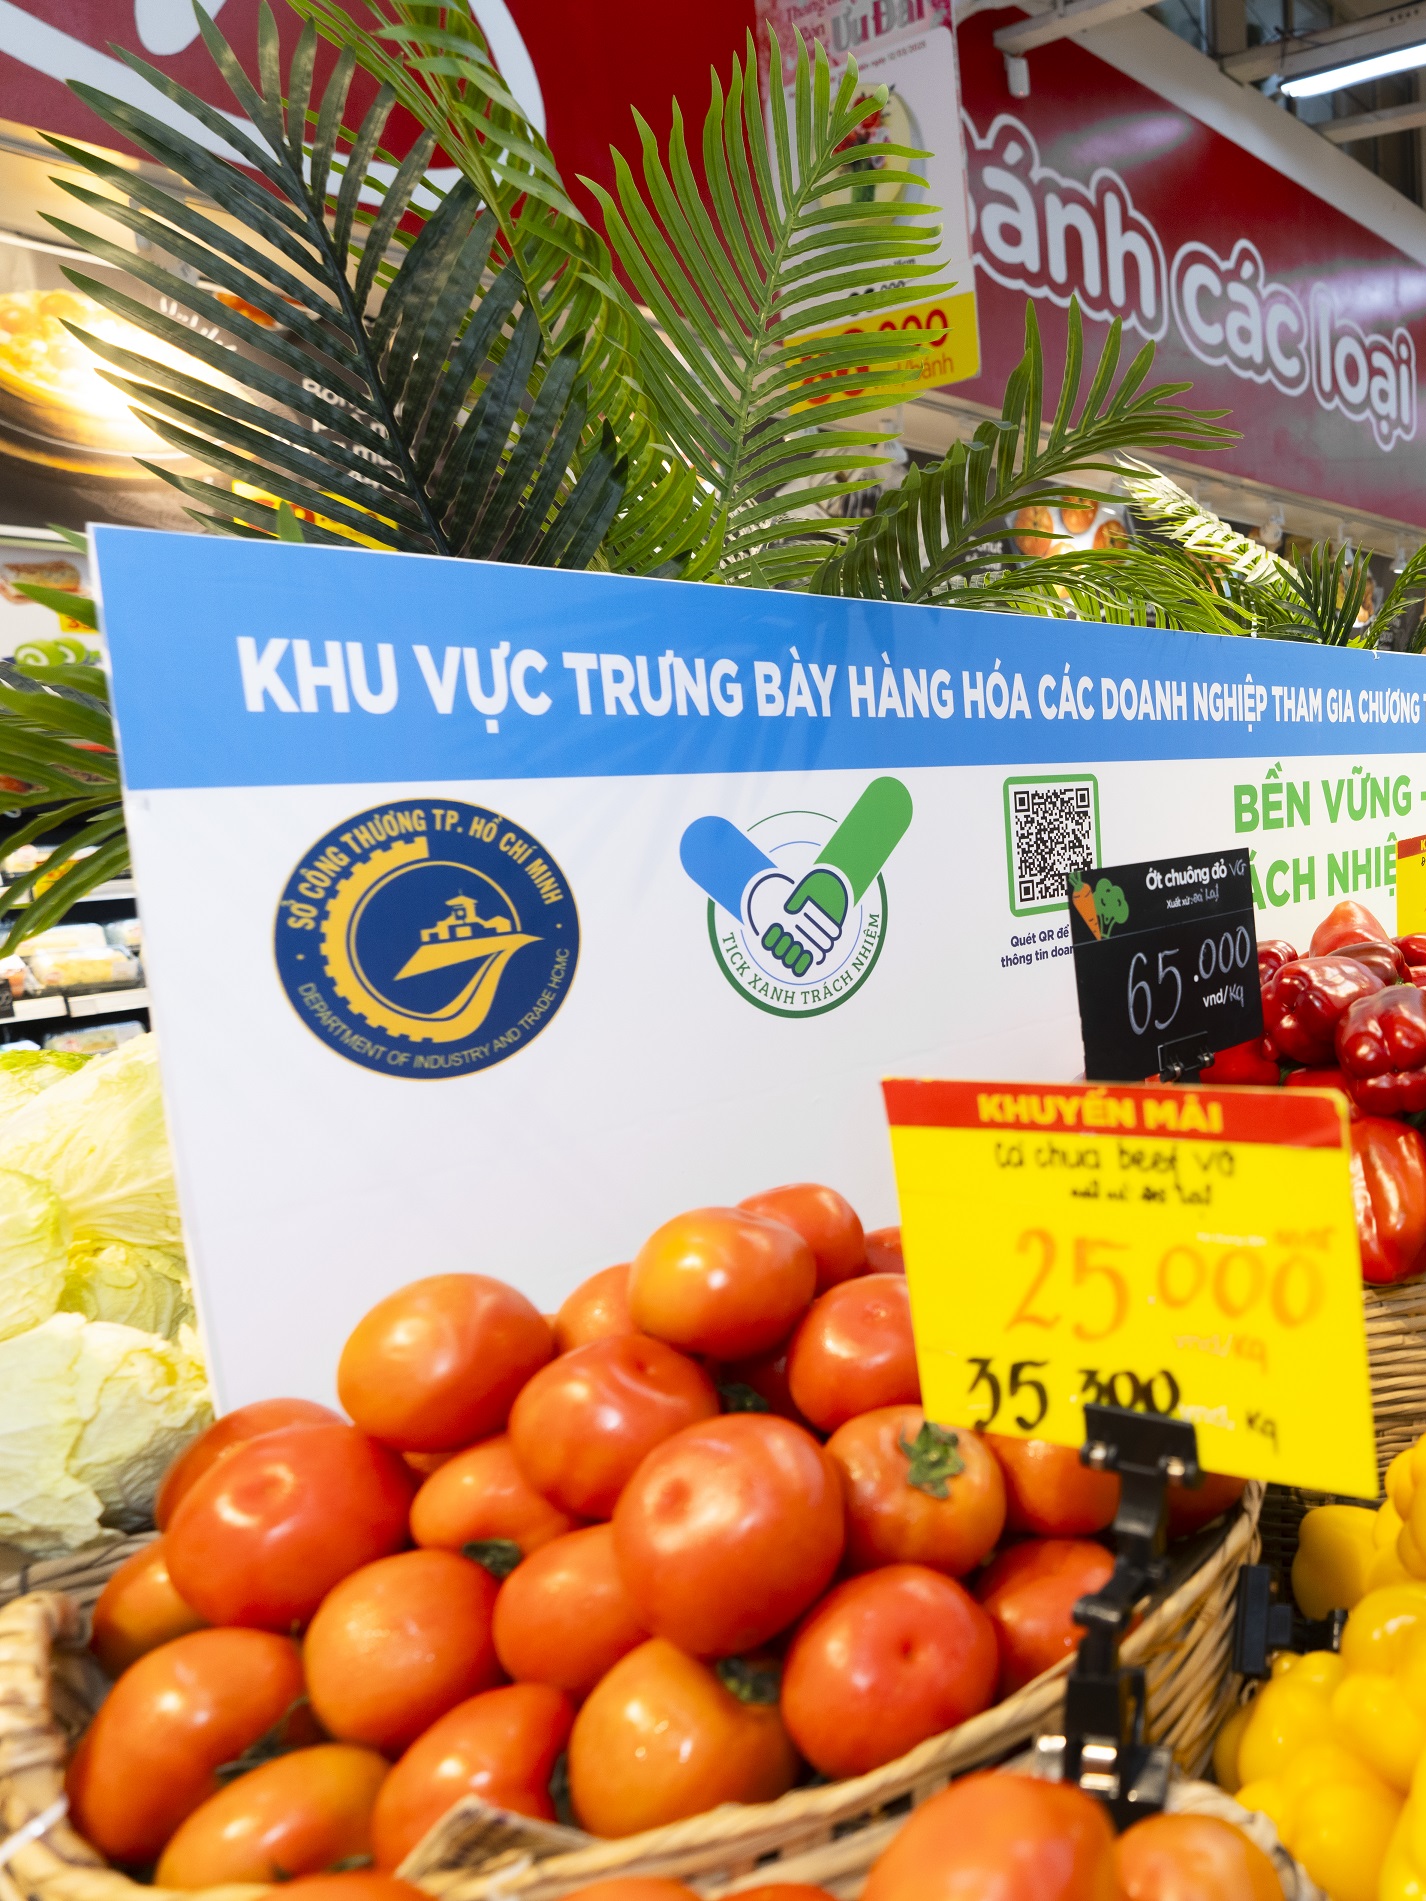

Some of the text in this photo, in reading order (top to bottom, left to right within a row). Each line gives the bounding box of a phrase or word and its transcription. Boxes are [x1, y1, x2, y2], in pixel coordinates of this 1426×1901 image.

[970, 138, 1412, 438] ánh các loại
[236, 636, 398, 714] KHU
[411, 640, 553, 734] VỰC
[562, 649, 744, 718] TRƯNG
[754, 645, 837, 717] BÀY
[848, 651, 953, 719] HÀNG
[962, 658, 1032, 720] HÓA
[1038, 662, 1095, 721] CÁC
[1101, 678, 1188, 721] DOANH
[1193, 673, 1267, 732] NGHIỆP
[1271, 686, 1323, 723] THAM
[1326, 688, 1355, 723] GIA
[1358, 687, 1420, 725] CHƯƠNG
[1233, 761, 1311, 834] BỀN
[1321, 765, 1412, 824] VỮNG
[281, 808, 564, 931] SỞ CÔNG THƯƠNG TP. HỒ CHÍ MINH
[1145, 866, 1163, 891] Ớt
[1165, 862, 1210, 889] chuông
[1212, 858, 1227, 881] đỏ
[1249, 848, 1321, 911] ÁCH
[1325, 831, 1397, 899] NHIỆ
[722, 912, 881, 1005] TICK XANH TRÁCH NHIỆM
[1000, 951, 1033, 968] thông
[1035, 948, 1049, 963] tin
[1010, 924, 1069, 948] Quét QR để
[298, 947, 570, 1069] DEPARTMENT OF INDUSTRY AND TRADE HCMC
[1127, 925, 1251, 1035] 65.000
[976, 1087, 1138, 1129] KHUYẾN
